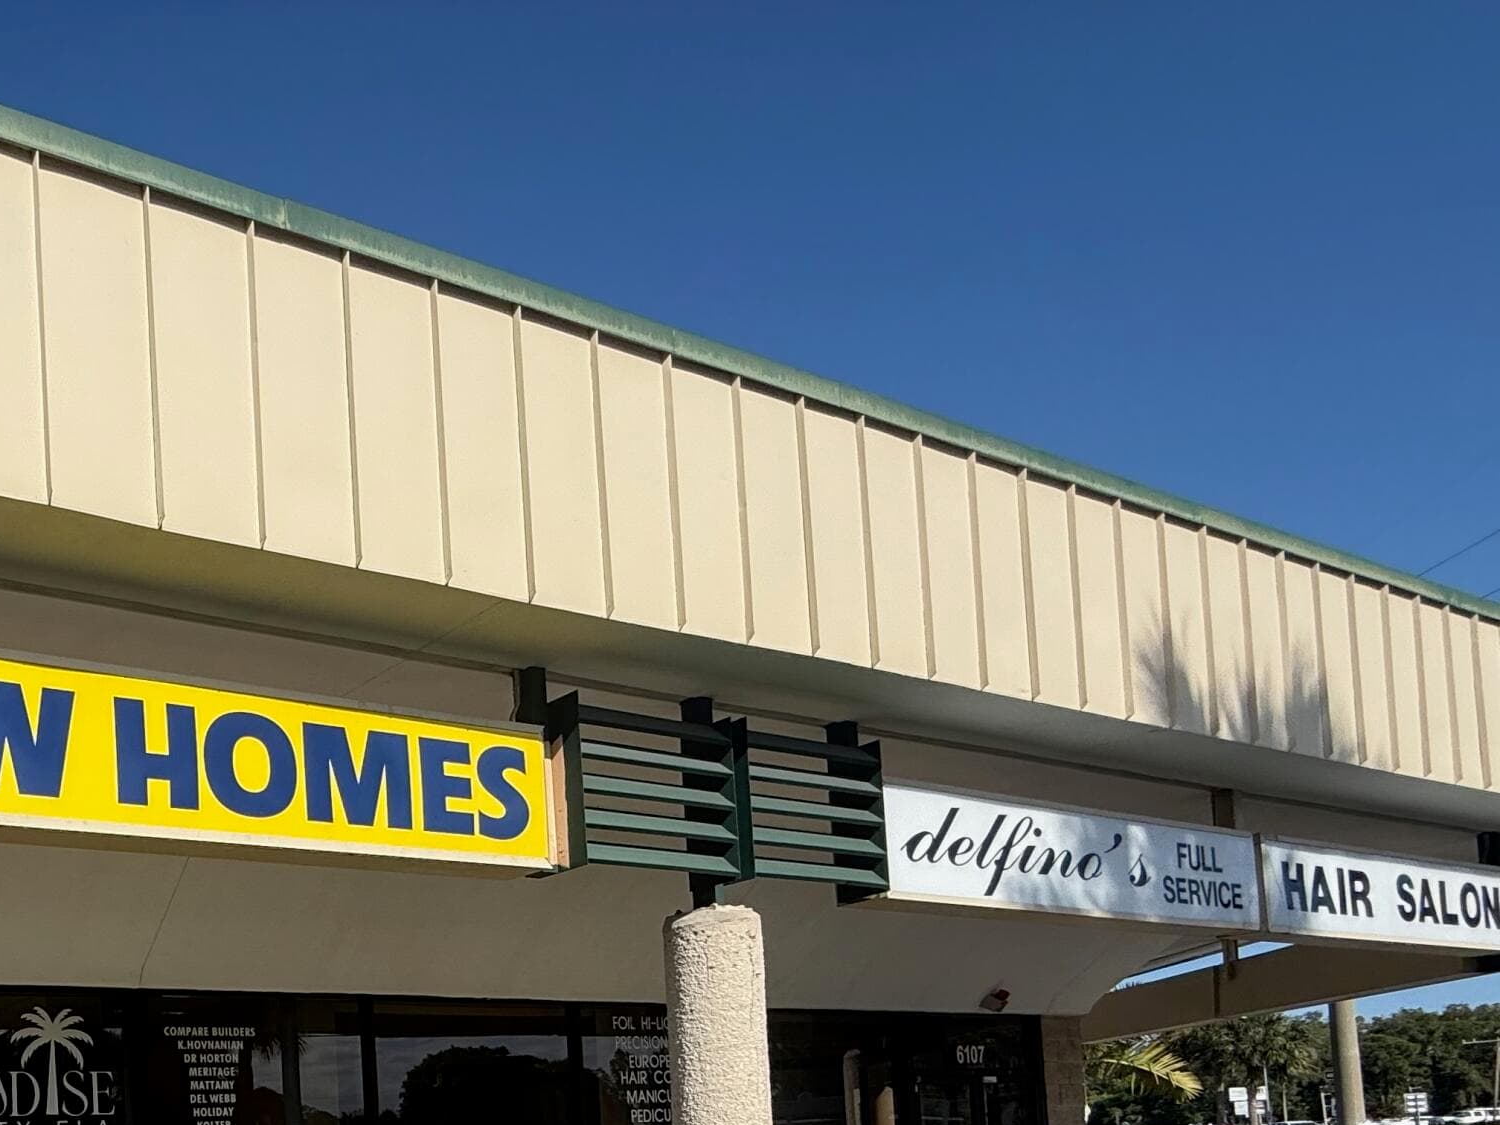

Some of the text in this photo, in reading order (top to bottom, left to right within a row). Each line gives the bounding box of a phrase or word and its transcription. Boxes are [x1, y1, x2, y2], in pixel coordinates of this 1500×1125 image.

[114, 698, 531, 840] HOMES
[900, 807, 1151, 897] delfino's
[1176, 842, 1223, 873] FULL
[1163, 876, 1244, 909] SERVICE
[1281, 861, 1500, 930] HAIR SALON
[612, 1016, 636, 1030] FOIL
[164, 1026, 256, 1037] COMPARE BUILDERS
[615, 1036, 668, 1049] PRECISION
[184, 1053, 239, 1063] DR HORTON
[956, 1045, 985, 1064] 6107
[189, 1067, 236, 1077] MERITAGE
[620, 1070, 648, 1085] HAIR
[190, 1080, 235, 1090] MATTAMY
[190, 1093, 236, 1104] DEL WEBB
[193, 1107, 234, 1117] HOLIDAY
[631, 1108, 672, 1123] PEDICU
